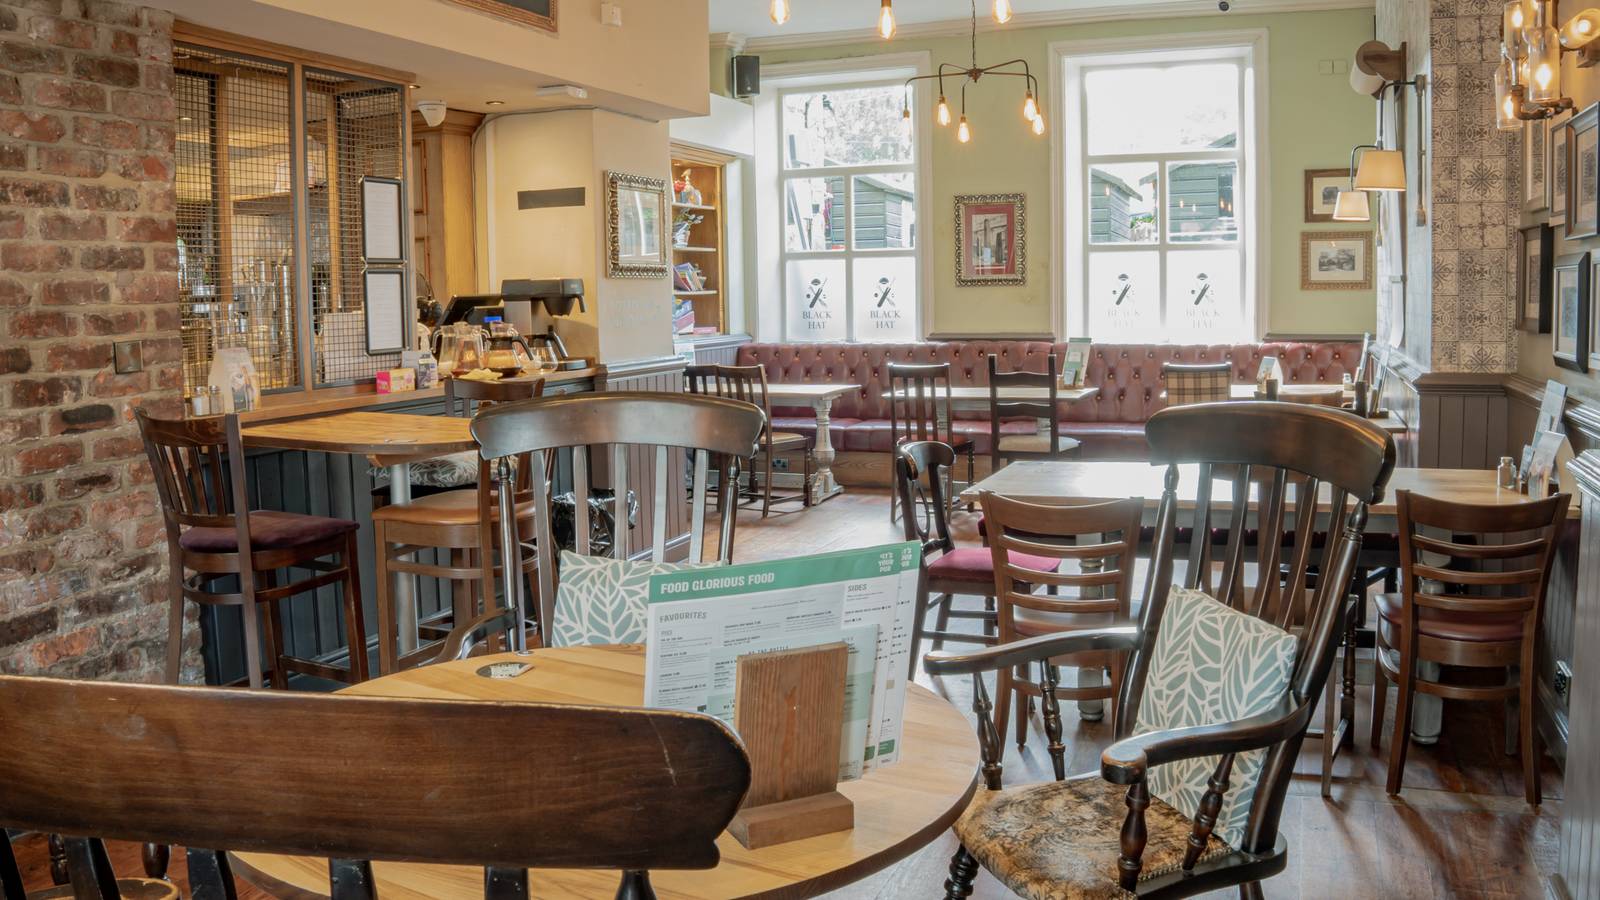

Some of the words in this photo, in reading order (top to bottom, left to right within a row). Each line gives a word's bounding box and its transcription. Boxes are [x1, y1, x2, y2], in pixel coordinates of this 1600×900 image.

[802, 311, 832, 319] BLACK
[870, 310, 901, 318] BLACK
[808, 321, 826, 329] HAT
[876, 320, 895, 328] HAT
[660, 582, 689, 594] FOOD
[692, 576, 745, 591] GLORIOUS
[748, 572, 775, 584] FOOD
[847, 584, 867, 592] SIDES
[659, 611, 707, 623] FAVOURITES
